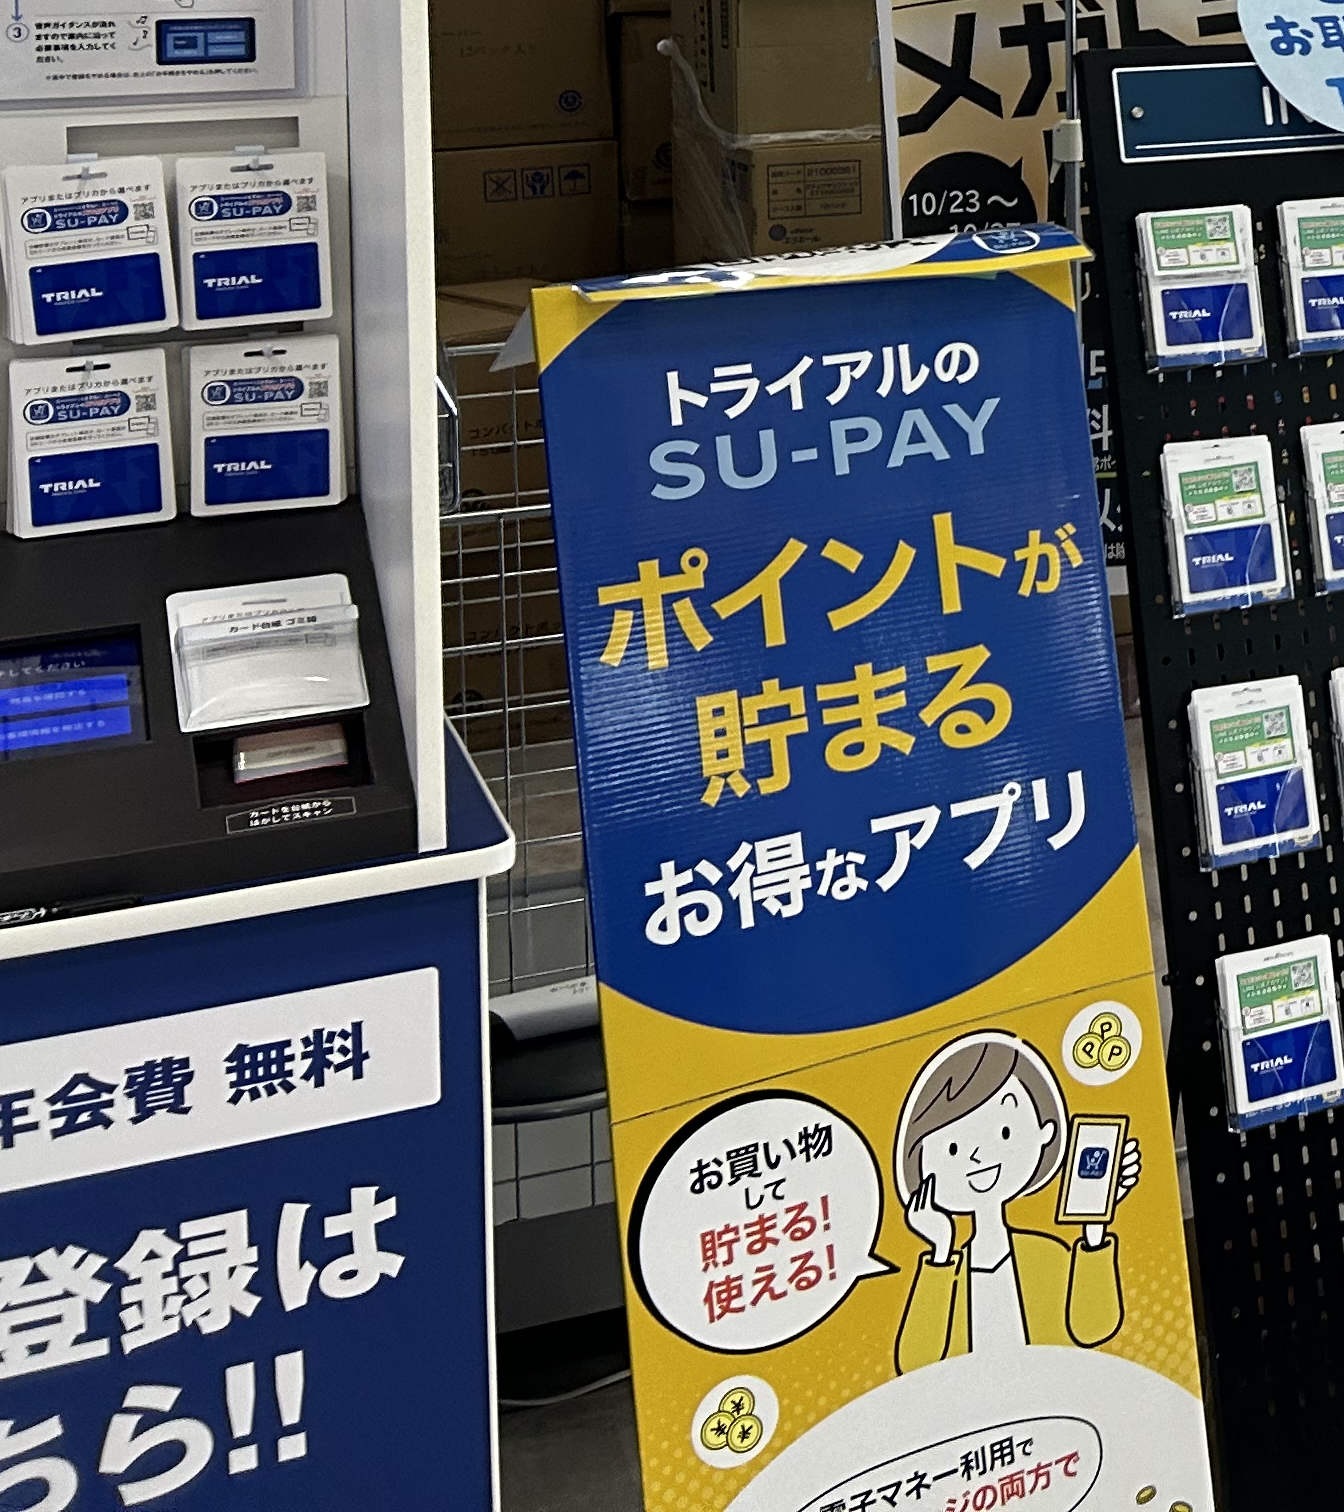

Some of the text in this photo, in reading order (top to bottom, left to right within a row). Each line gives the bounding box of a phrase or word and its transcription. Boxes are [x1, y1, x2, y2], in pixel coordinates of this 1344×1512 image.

[220, 203, 283, 217] SU-PAY
[55, 213, 119, 229] SU-PAY
[203, 274, 263, 289] TRIAL
[42, 288, 103, 304] TRIAL
[1169, 309, 1211, 320] TRIAL
[665, 340, 981, 427] トライアルの
[232, 388, 295, 402] SU-PAY
[56, 405, 121, 420] SU-PAY
[647, 396, 1001, 503] SU-PAY
[213, 460, 272, 474] TRIAL
[39, 478, 102, 494] TRIAL
[1192, 552, 1234, 566] TRIAL
[596, 511, 1086, 672] ポイントが
[693, 642, 1015, 809] 貯まる
[1224, 801, 1266, 816] TRIAL
[642, 769, 1090, 947] お得なアプリ
[224, 1021, 371, 1106] 無料
[1250, 1055, 1294, 1074] TRIAL
[688, 1123, 835, 1196] お買い物
[743, 1182, 787, 1211] して
[698, 1195, 833, 1272] 貯まる!
[0, 1185, 406, 1380] 登録は
[702, 1244, 838, 1324] 使える!
